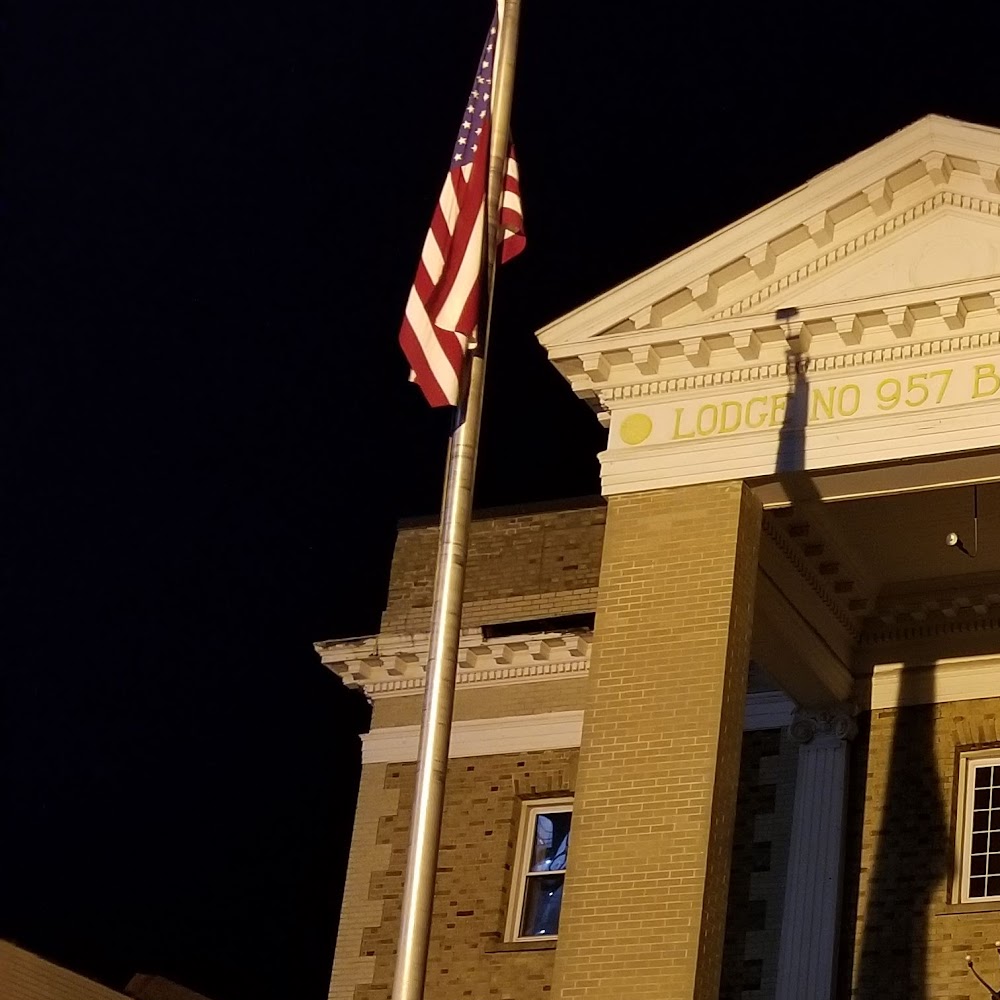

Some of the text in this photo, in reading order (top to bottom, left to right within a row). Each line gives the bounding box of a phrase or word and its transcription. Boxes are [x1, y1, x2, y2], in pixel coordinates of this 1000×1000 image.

[673, 393, 792, 440] LODGE
[809, 385, 861, 421] NO
[875, 369, 951, 411] 957
[971, 363, 1000, 399] B
